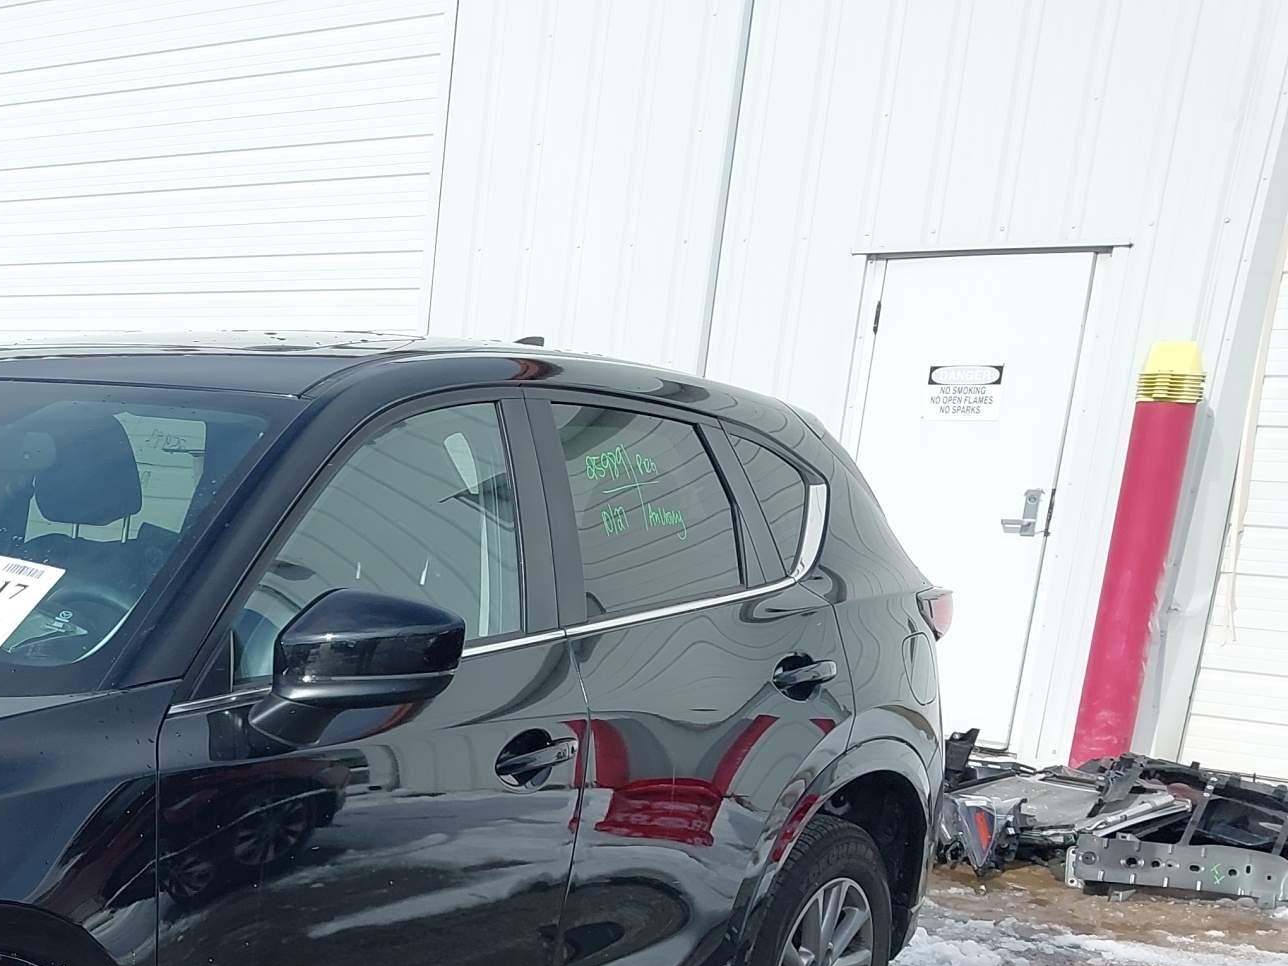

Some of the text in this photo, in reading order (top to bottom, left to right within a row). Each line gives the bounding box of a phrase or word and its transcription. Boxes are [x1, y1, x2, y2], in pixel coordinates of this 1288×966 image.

[939, 386, 987, 395] NO SMOKING
[930, 395, 994, 405] NO OPEN FLAMES
[939, 405, 981, 414] NO SPARKS
